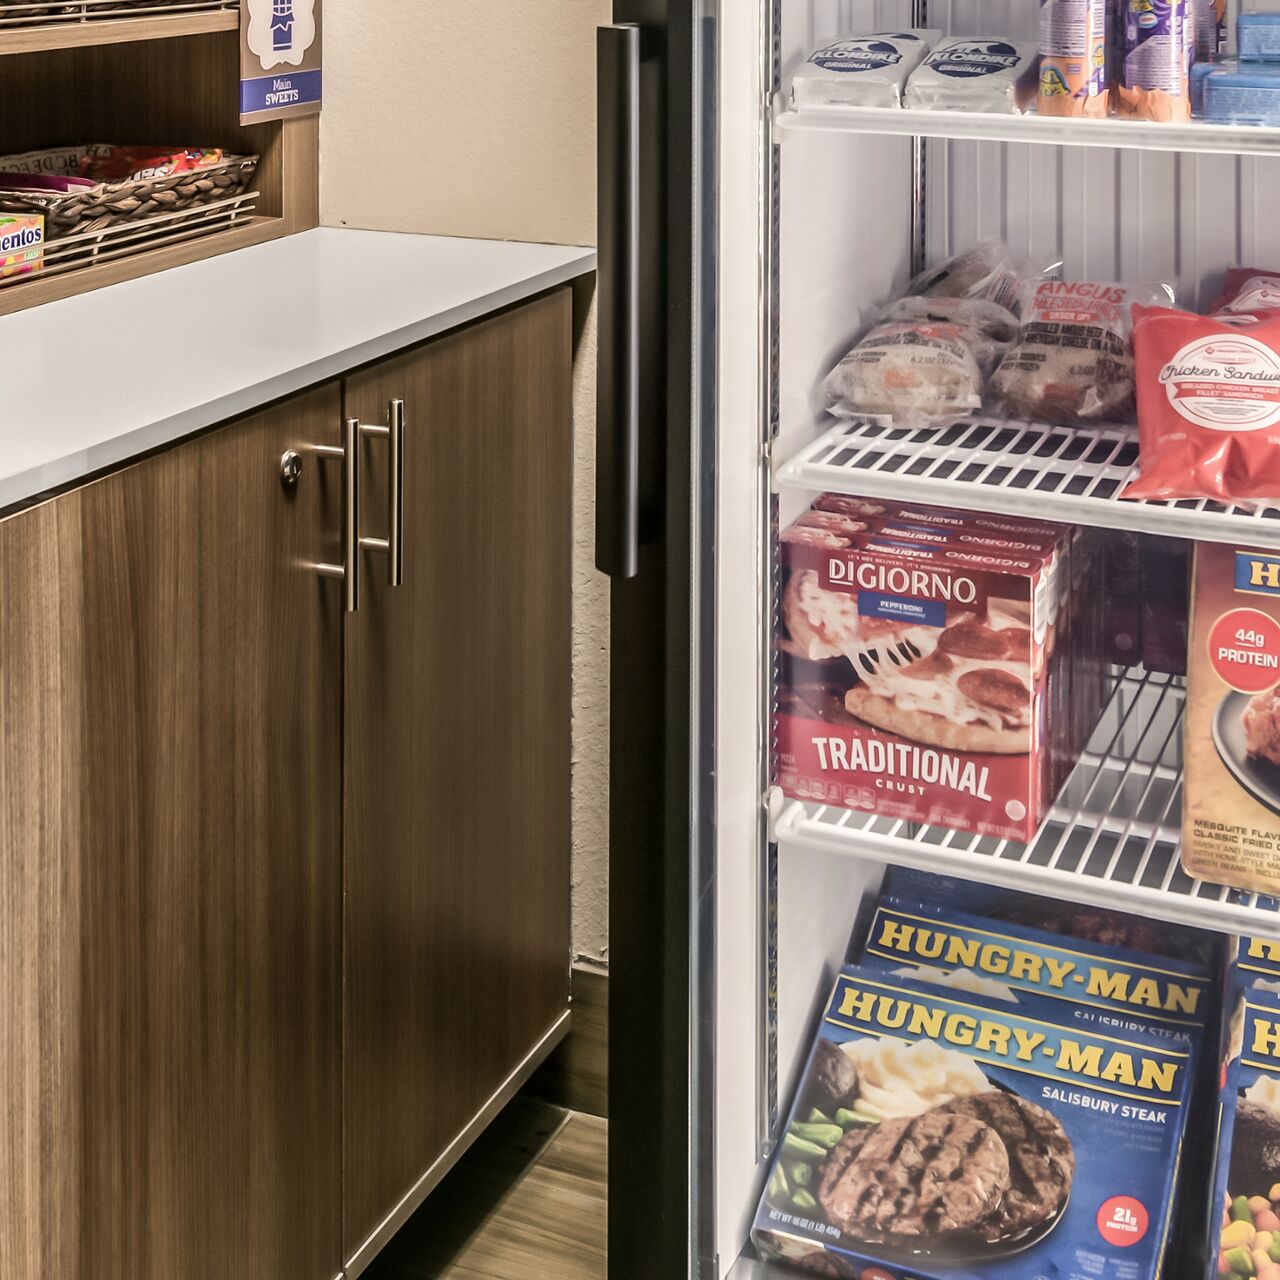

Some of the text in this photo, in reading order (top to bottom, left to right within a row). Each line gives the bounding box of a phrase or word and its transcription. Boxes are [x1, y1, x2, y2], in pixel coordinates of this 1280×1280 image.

[808, 49, 902, 66] KLONDIKE
[823, 61, 874, 71] ORIGINAL
[923, 50, 1021, 68] KLONDIKE
[938, 64, 988, 74] ORIGINAL
[273, 79, 291, 91] Main
[265, 90, 298, 105] SWEETS
[1037, 282, 1126, 304] ANGUS
[1161, 365, 1220, 382] Chicken
[880, 600, 923, 613] PEPPERONI
[1235, 628, 1264, 648] 44g
[1219, 648, 1278, 668] PROTEIN
[812, 737, 993, 802] TRADITIONAL
[875, 779, 926, 796] CRUST
[1194, 820, 1247, 835] MESQUITE
[1194, 829, 1238, 844] CLASSIC
[1243, 838, 1272, 850] FRIED
[1224, 846, 1240, 855] AND
[879, 921, 1200, 1014] HUNGRY-MAN
[838, 987, 1181, 1093] HUNGRY-MAN
[1042, 1086, 1167, 1123] SALISBURY STEAK
